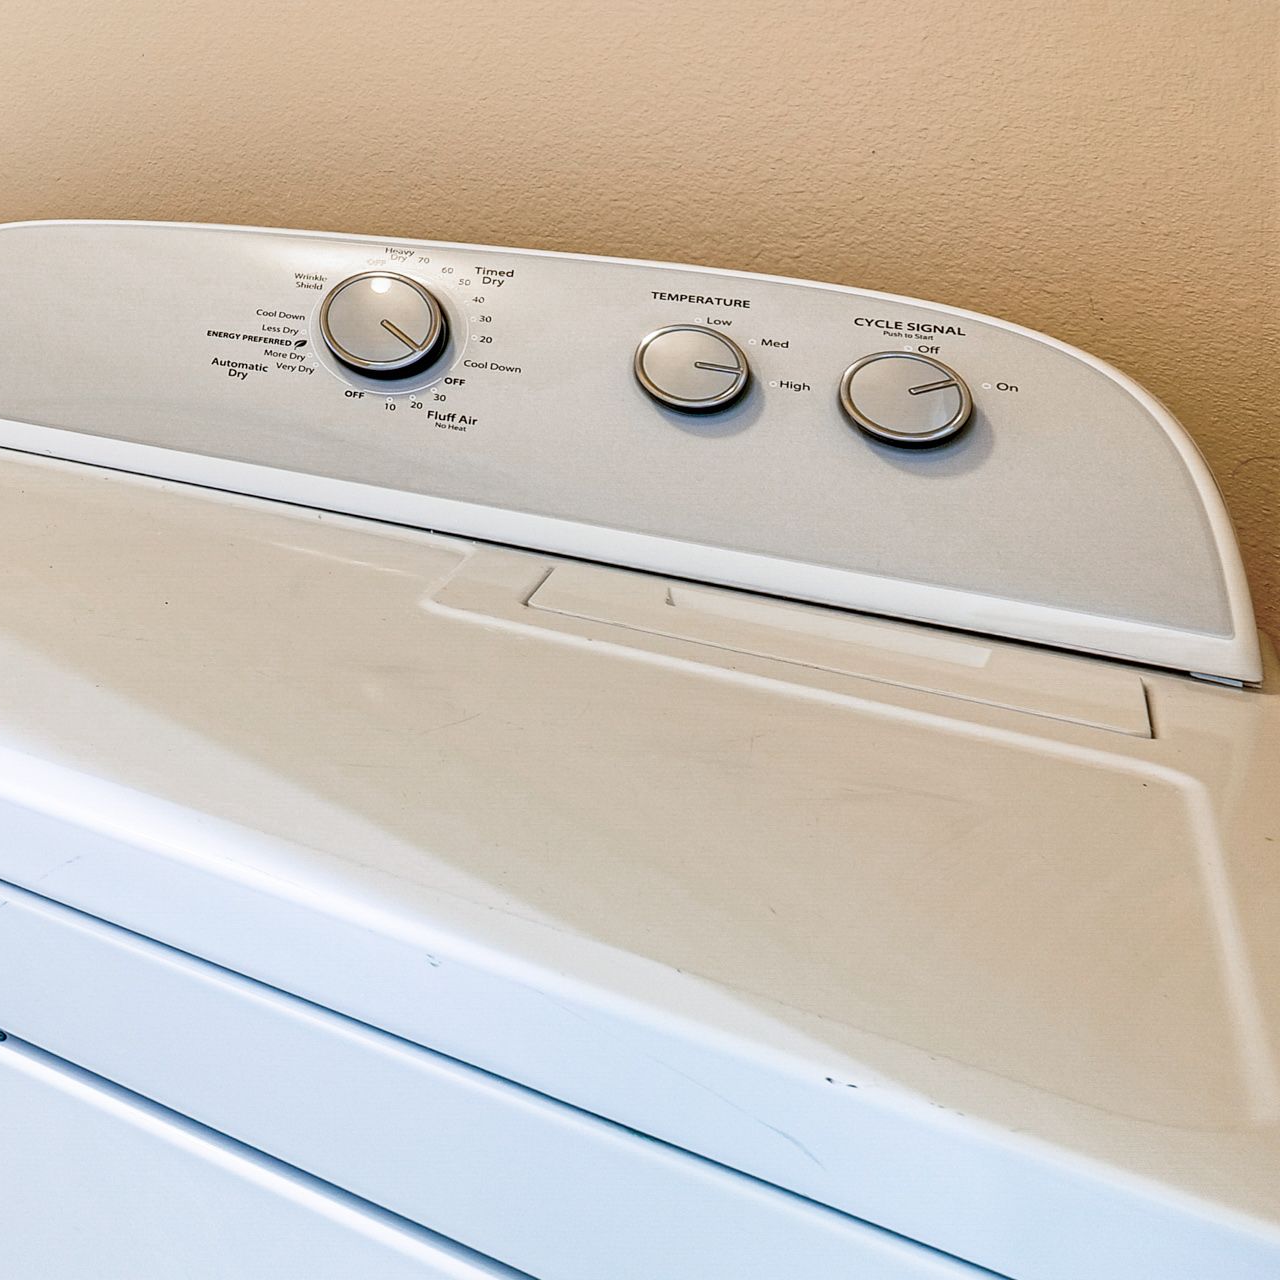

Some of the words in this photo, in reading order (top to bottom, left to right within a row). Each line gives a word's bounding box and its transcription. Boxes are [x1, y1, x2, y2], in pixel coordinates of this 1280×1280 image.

[385, 247, 415, 257] Heavy
[390, 254, 408, 263] Dry
[294, 273, 328, 282] Wrinkle
[474, 266, 515, 279] Timed
[295, 281, 323, 291] Shield
[457, 278, 471, 287] 50
[482, 276, 505, 288] Dry
[471, 295, 485, 304] 40
[651, 291, 751, 309] TEMPERATURE
[255, 308, 278, 319] Cool
[279, 310, 306, 322] Down
[479, 315, 493, 324] 30
[706, 317, 733, 328] Low
[853, 317, 904, 333] CYCLE
[906, 321, 967, 337] SIGNAL
[261, 324, 283, 334] Less
[284, 327, 300, 338] Dry
[883, 330, 902, 339] Push
[914, 333, 934, 342] Start
[206, 329, 241, 341] ENERGY
[242, 334, 292, 348] PREFERRED
[479, 335, 493, 345] 20
[761, 338, 790, 349] Med
[917, 344, 941, 355] Off
[263, 349, 286, 360] More
[288, 352, 306, 364] Dry
[211, 357, 269, 373] Automatic
[275, 362, 296, 374] Very
[297, 364, 316, 376] Dry
[463, 358, 489, 371] Cool
[491, 362, 523, 374] Down
[228, 368, 249, 381] Dry
[444, 376, 466, 387] OFF
[779, 380, 811, 392] High
[996, 382, 1019, 393] On
[344, 389, 366, 400] OFF
[433, 393, 447, 403] 30
[384, 402, 396, 412] 10
[409, 401, 424, 410] 20
[426, 410, 456, 424] Fluff
[458, 414, 479, 427] Air
[434, 421, 447, 429] No
[448, 424, 467, 433] Heat
